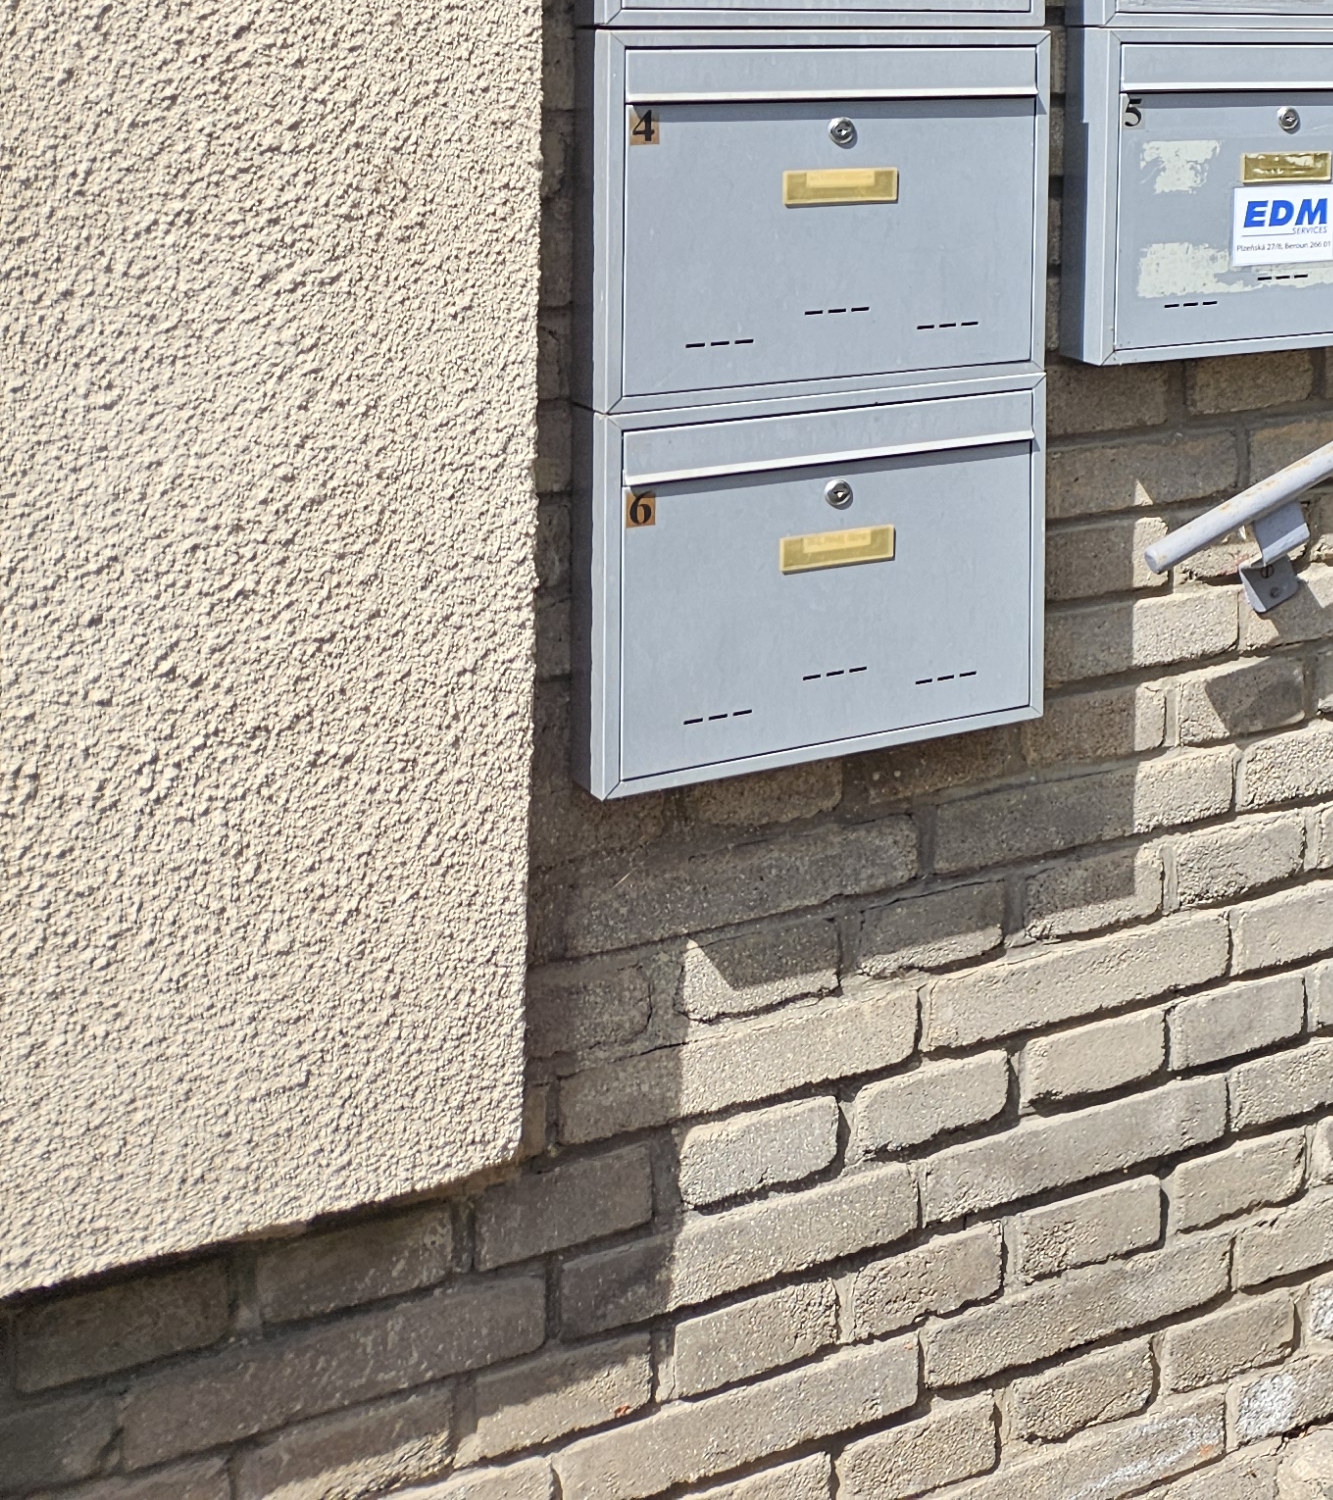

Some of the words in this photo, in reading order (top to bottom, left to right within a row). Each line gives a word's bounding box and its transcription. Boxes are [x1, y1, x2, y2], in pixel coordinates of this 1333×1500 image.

[631, 109, 655, 142] 4
[1124, 98, 1143, 128] 5
[1243, 198, 1328, 228] EDM
[1292, 226, 1328, 235] SERVICES
[628, 490, 653, 526] 6
